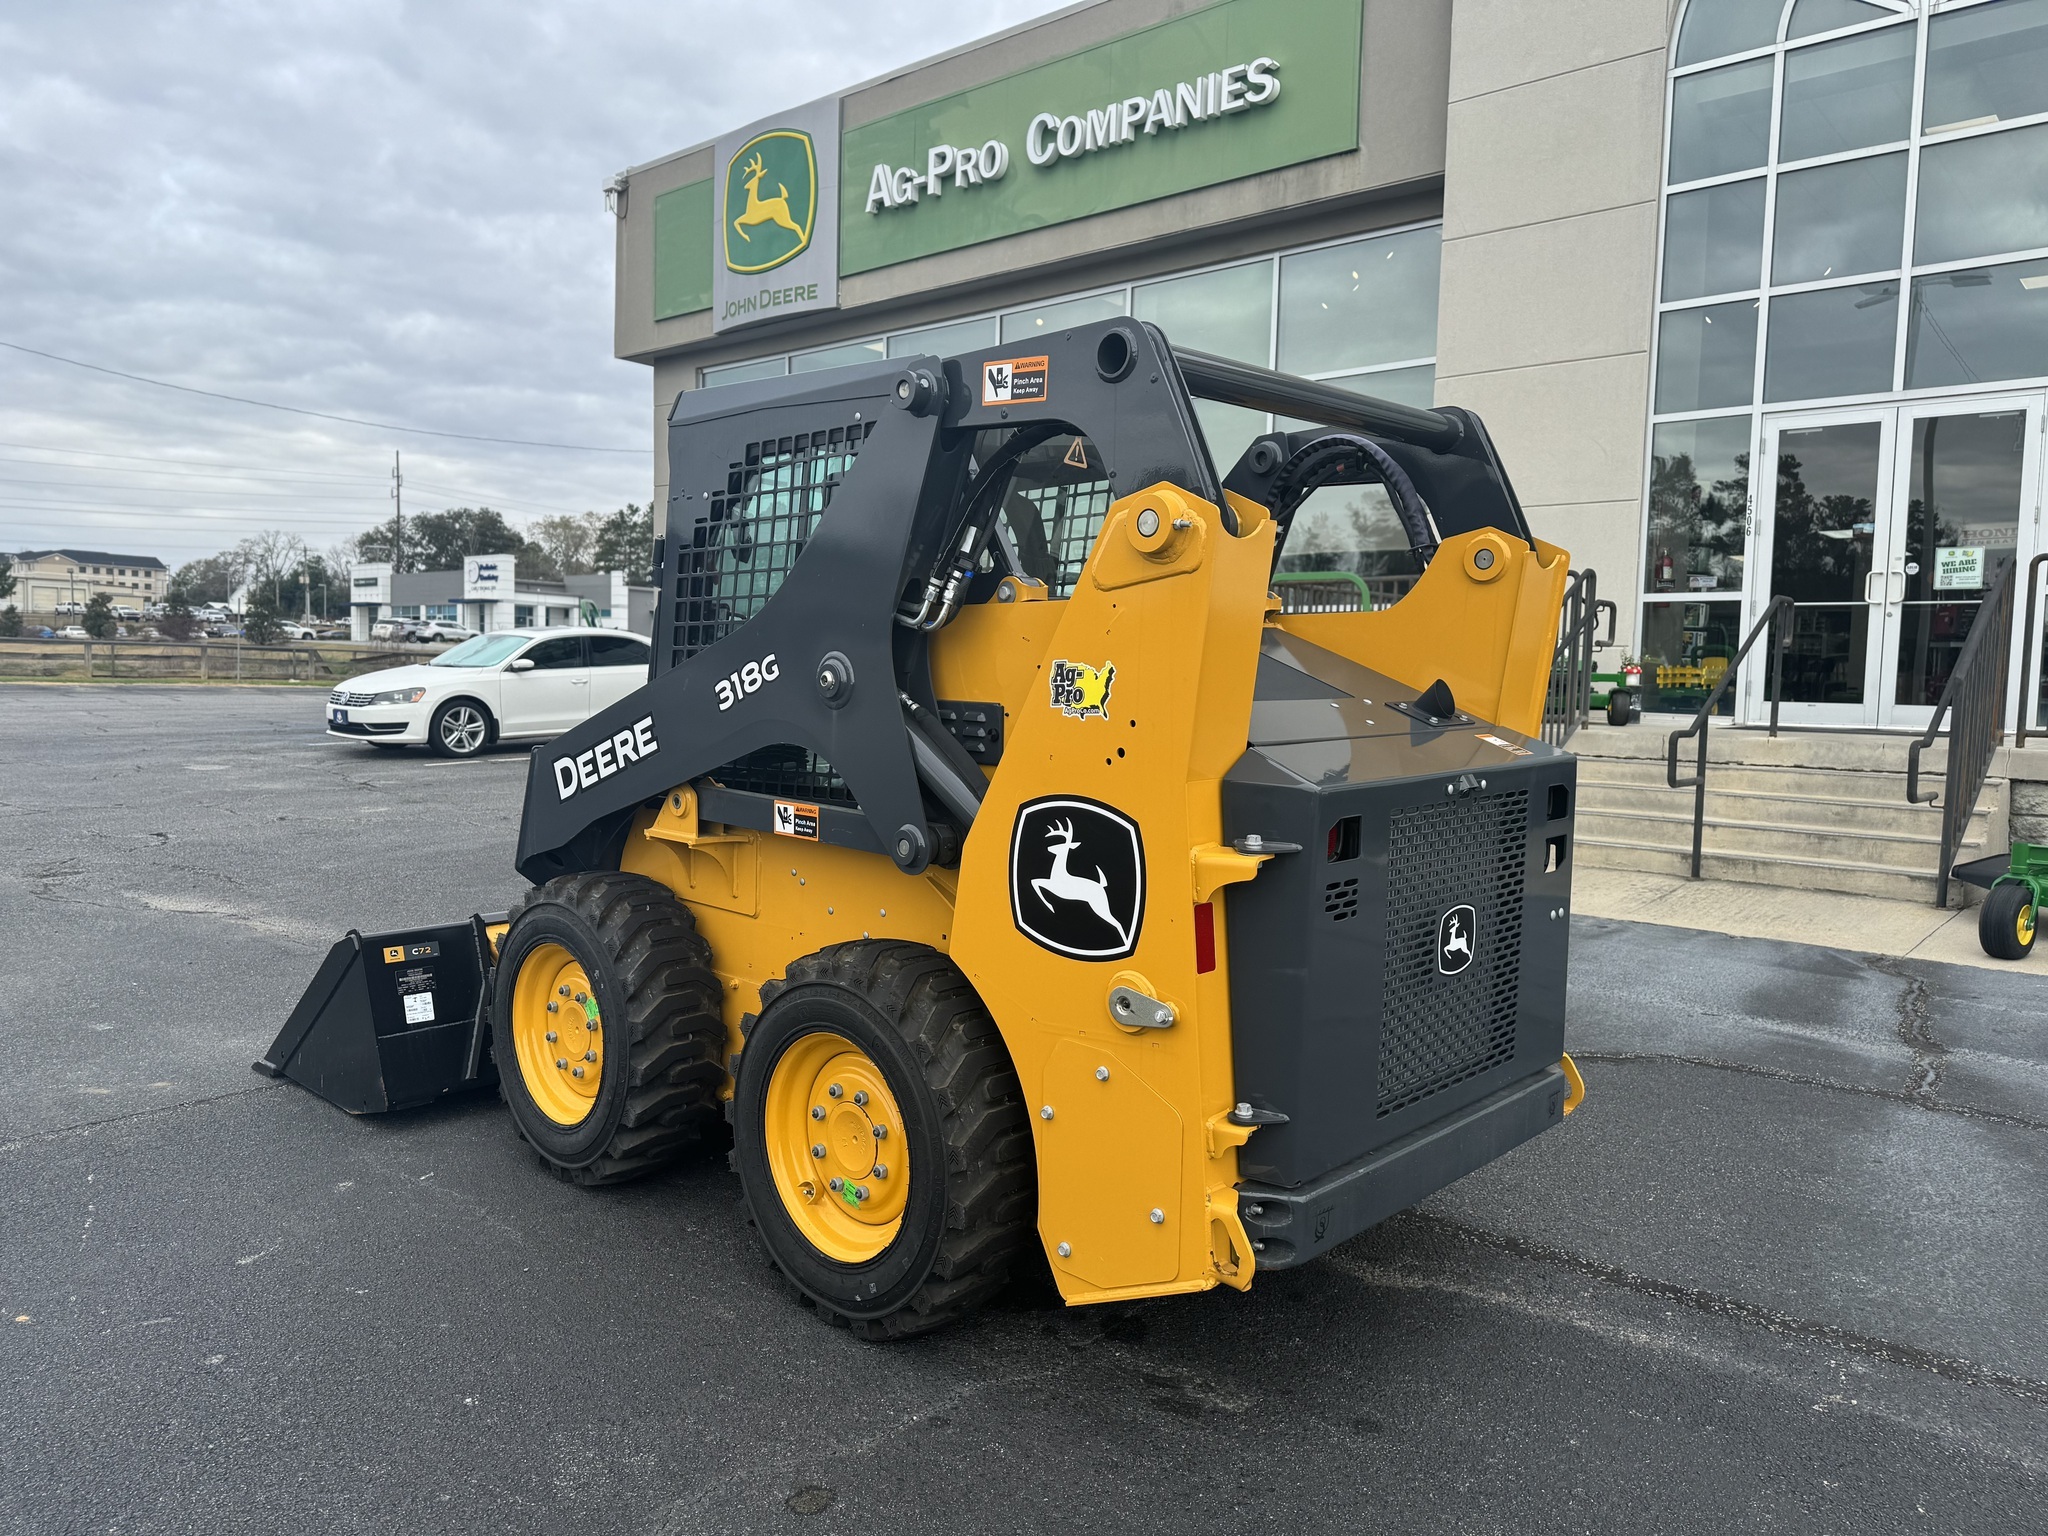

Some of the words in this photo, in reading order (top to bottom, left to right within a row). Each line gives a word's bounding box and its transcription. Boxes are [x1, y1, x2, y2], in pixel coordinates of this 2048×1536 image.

[1026, 56, 1281, 167] COMPANIES
[722, 296, 757, 320] JOHN
[760, 283, 818, 310] DEERE
[1021, 361, 1045, 369] WARNING
[1013, 378, 1029, 386] Pinch
[1942, 565, 1976, 574] HIRING
[714, 653, 780, 711] 318G
[1052, 684, 1084, 705] Pro
[553, 715, 658, 801] DEERE
[412, 946, 431, 955] C72
